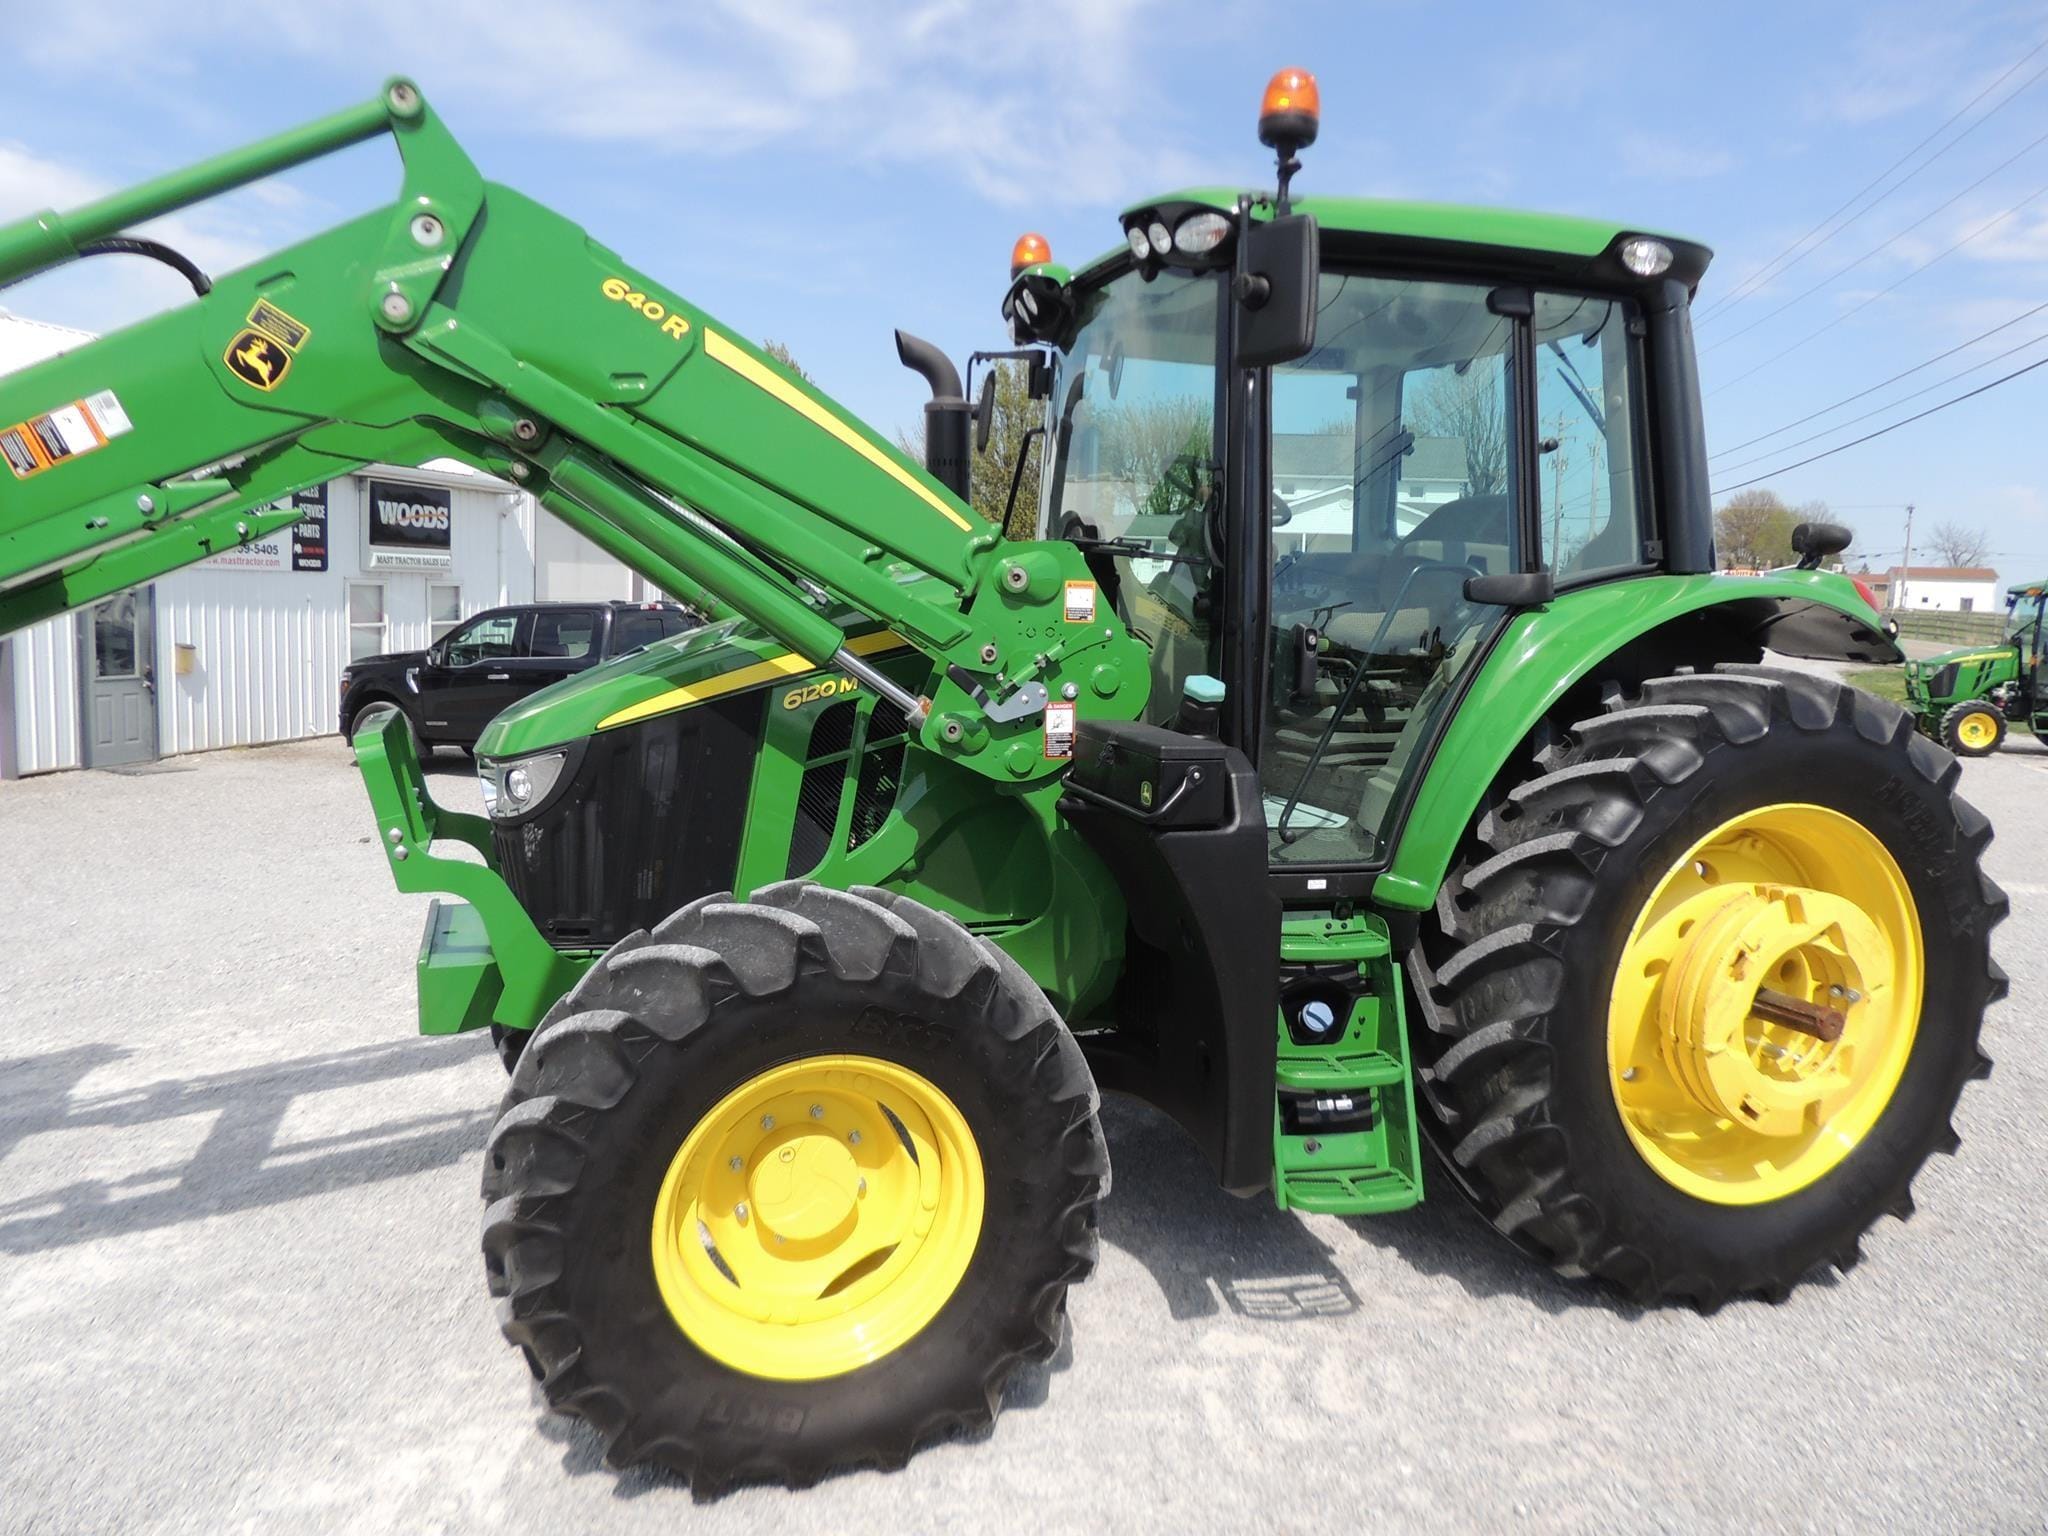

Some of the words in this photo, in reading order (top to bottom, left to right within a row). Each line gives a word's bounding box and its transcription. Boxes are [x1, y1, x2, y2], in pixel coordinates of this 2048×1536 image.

[377, 500, 449, 530] WOODS
[298, 524, 321, 538] PARTS
[395, 556, 421, 566] TRACTOR
